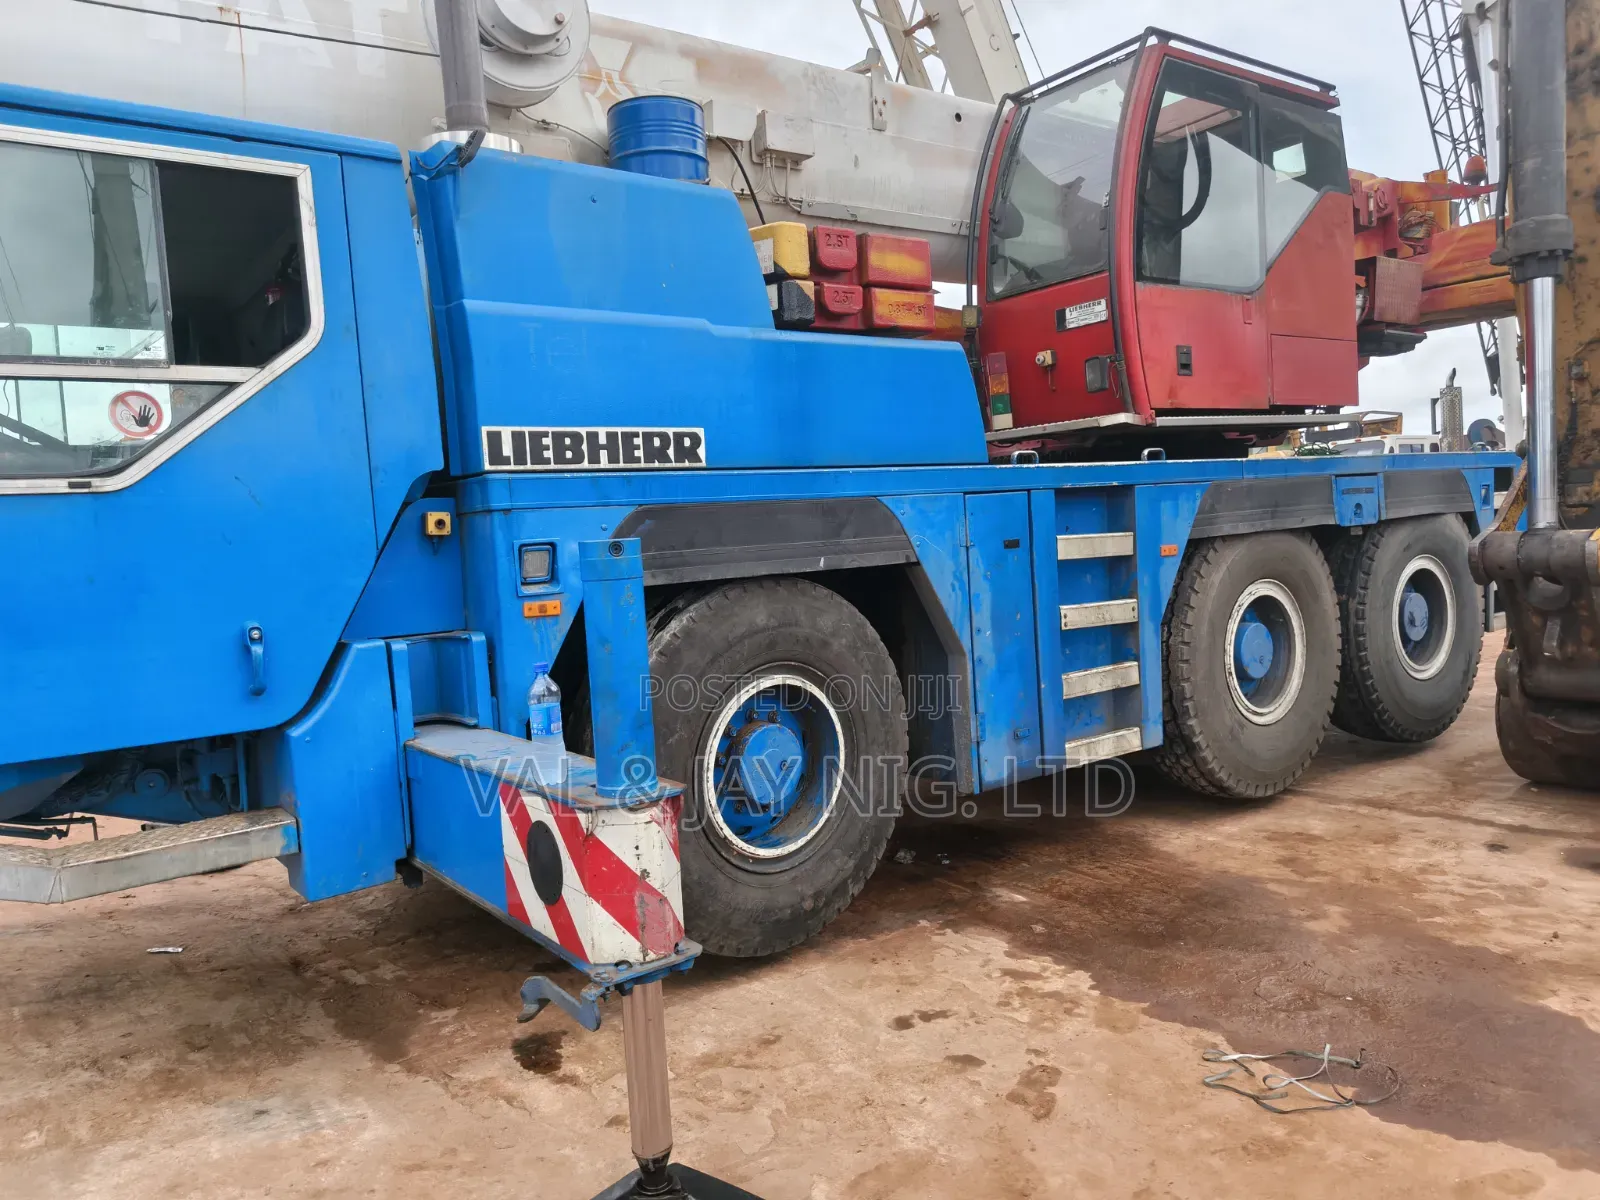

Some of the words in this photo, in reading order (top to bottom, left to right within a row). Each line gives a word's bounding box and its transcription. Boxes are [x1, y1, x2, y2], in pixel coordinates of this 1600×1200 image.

[825, 232, 850, 248] 2.5T
[1068, 300, 1102, 313] LIEBHERR
[486, 430, 703, 466] LIEBHERR
